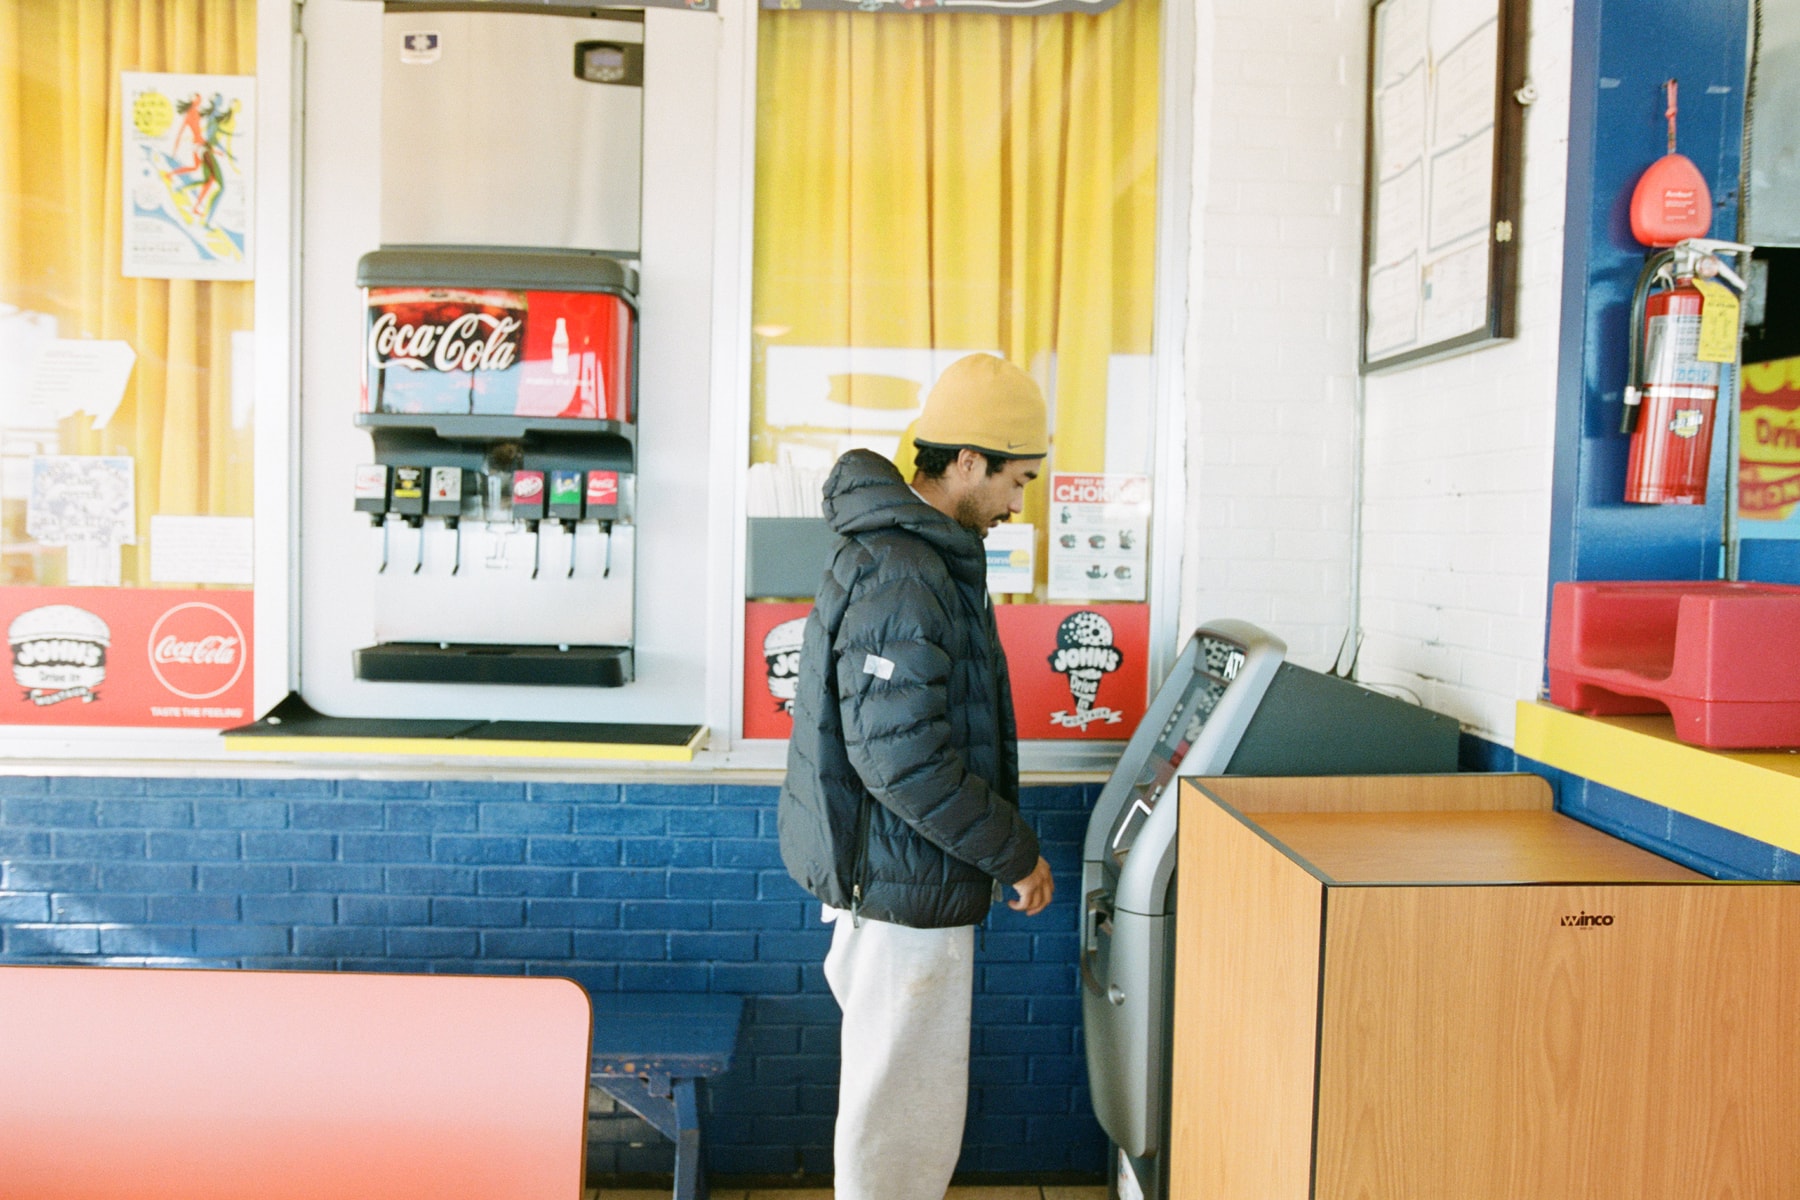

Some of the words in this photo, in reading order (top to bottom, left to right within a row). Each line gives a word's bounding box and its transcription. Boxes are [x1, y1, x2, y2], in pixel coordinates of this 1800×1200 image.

[368, 312, 521, 372] Coca-Cola
[155, 635, 238, 664] Coca-Cola
[1054, 647, 1120, 672] JOHN'S
[150, 706, 181, 718] TASTE
[182, 706, 201, 718] THE
[202, 706, 244, 719] FEELING
